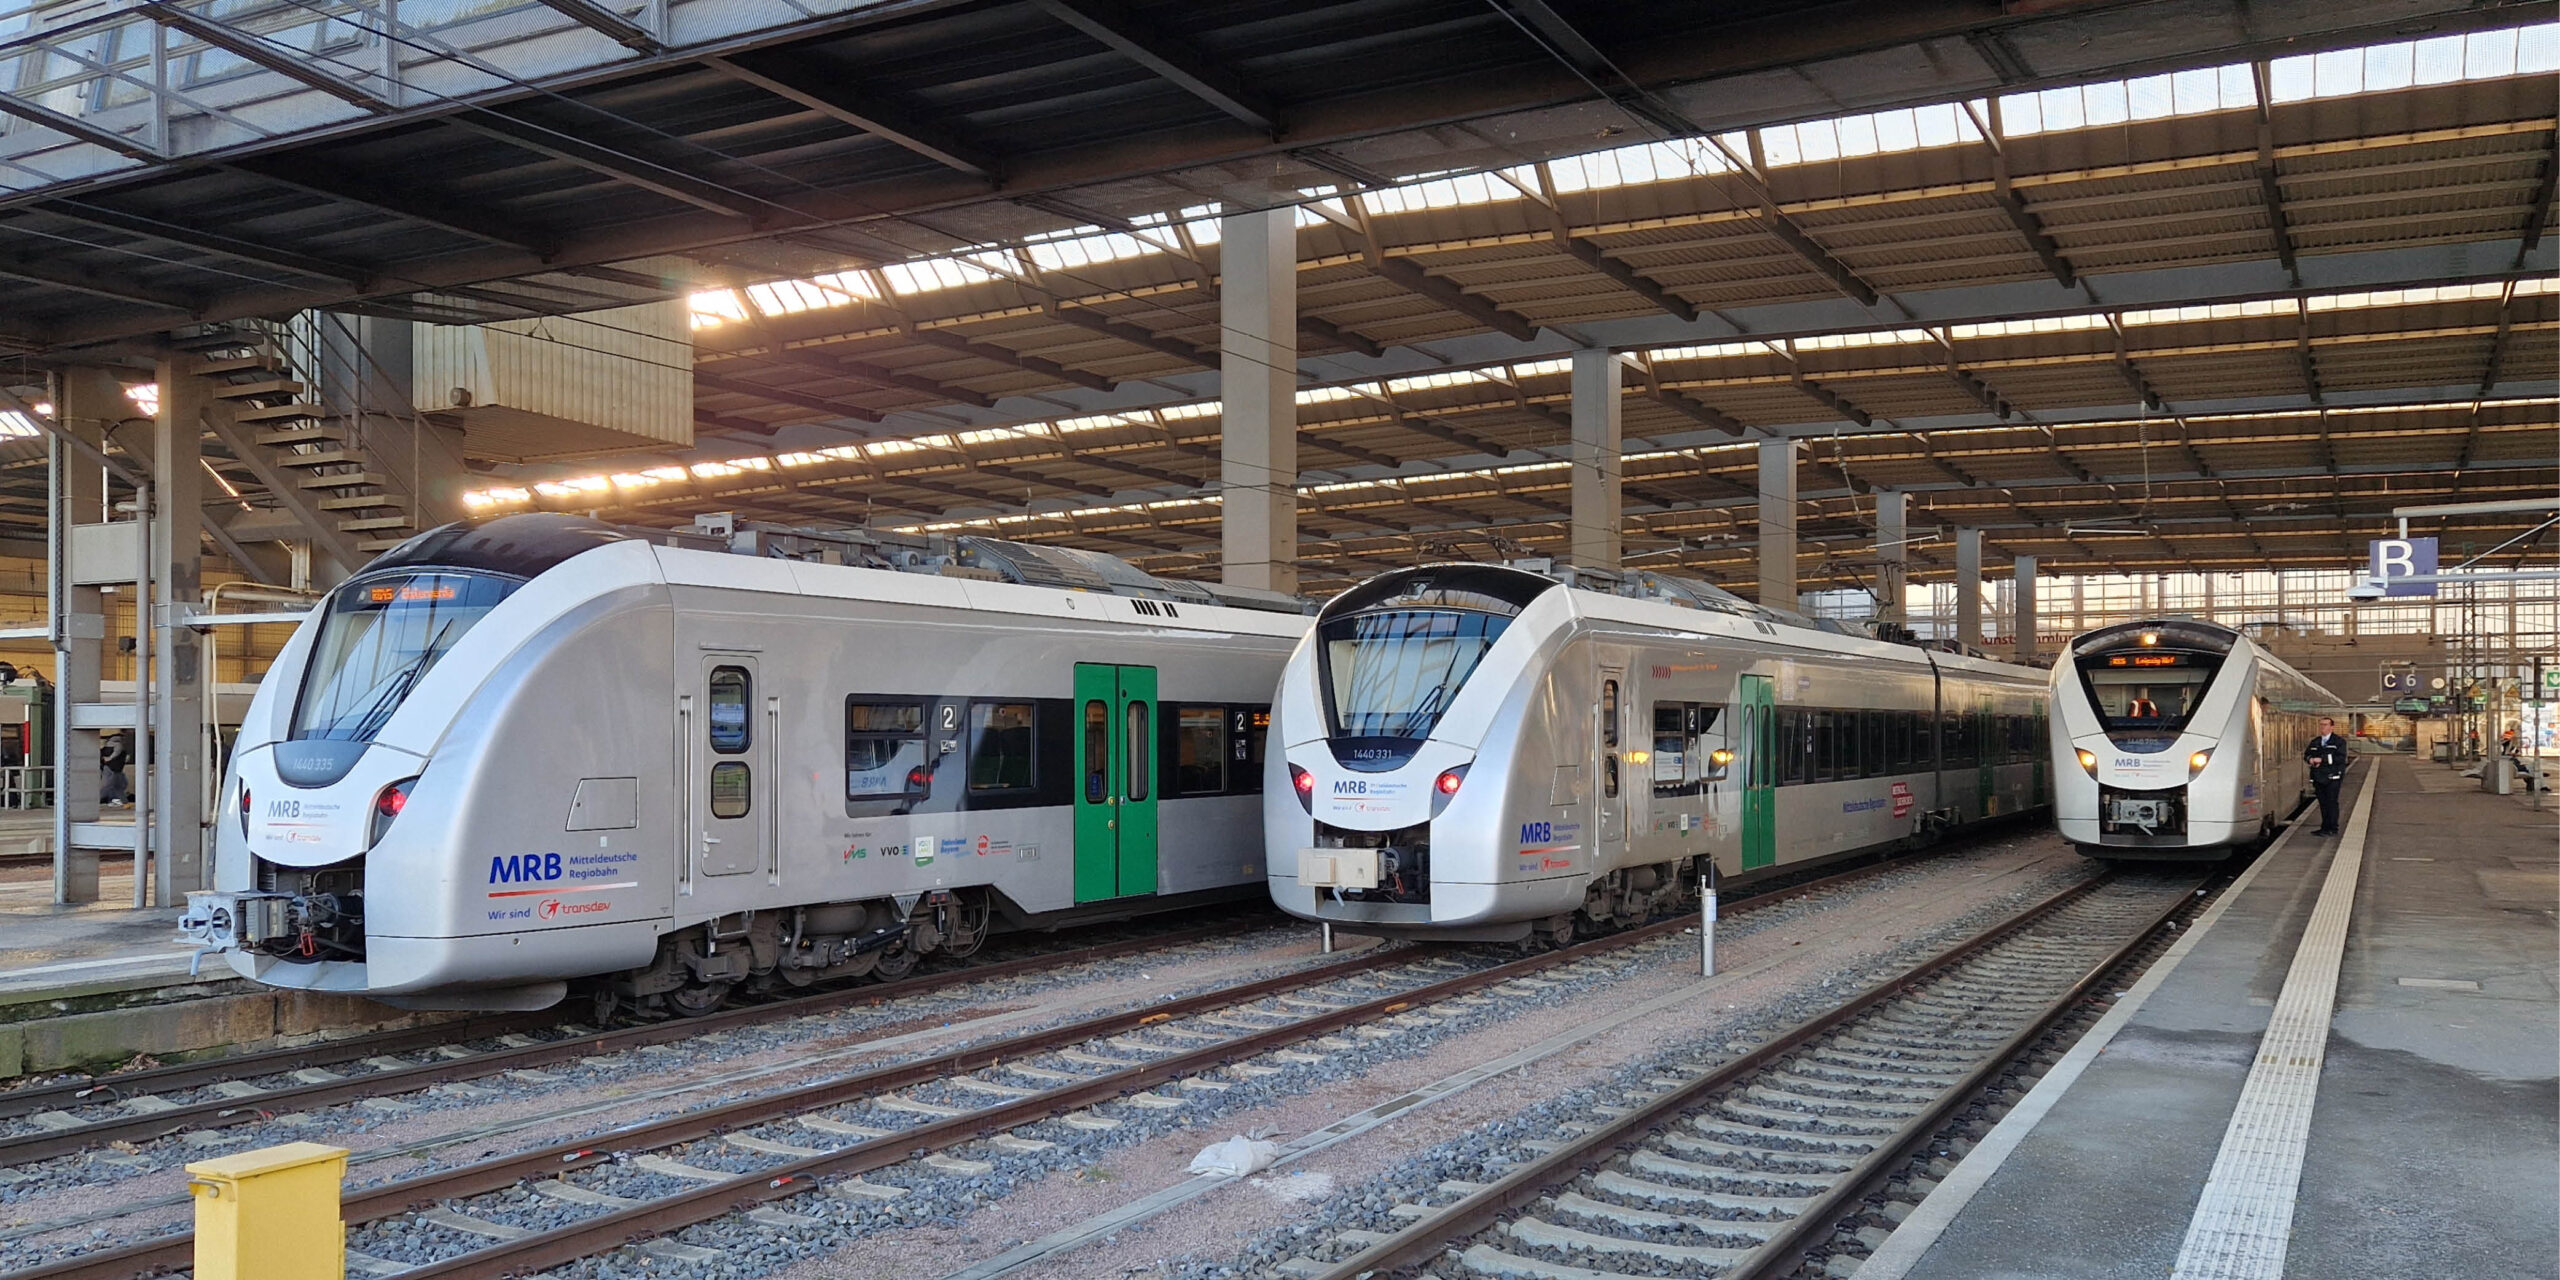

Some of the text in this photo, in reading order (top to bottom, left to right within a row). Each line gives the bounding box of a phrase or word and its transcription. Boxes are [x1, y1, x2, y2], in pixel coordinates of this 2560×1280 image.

[2379, 541, 2414, 577] B
[2384, 673, 2397, 688] C
[2406, 673, 2417, 687] 6
[943, 706, 954, 729] 2
[1237, 713, 1244, 730] 2
[1689, 711, 1696, 728] 2
[1354, 749, 1392, 759] 1440 331
[293, 758, 333, 771] 1440 335
[2115, 758, 2141, 767] MRB
[1333, 780, 1367, 794] MRB
[268, 800, 300, 818] MRB
[1520, 822, 1551, 844] MRB
[569, 851, 638, 865] Mitteldeutsche
[880, 846, 900, 857] VVO
[489, 852, 562, 884] MRB
[569, 866, 618, 881] Regiobahn
[488, 901, 612, 920] Wir sind transdev
